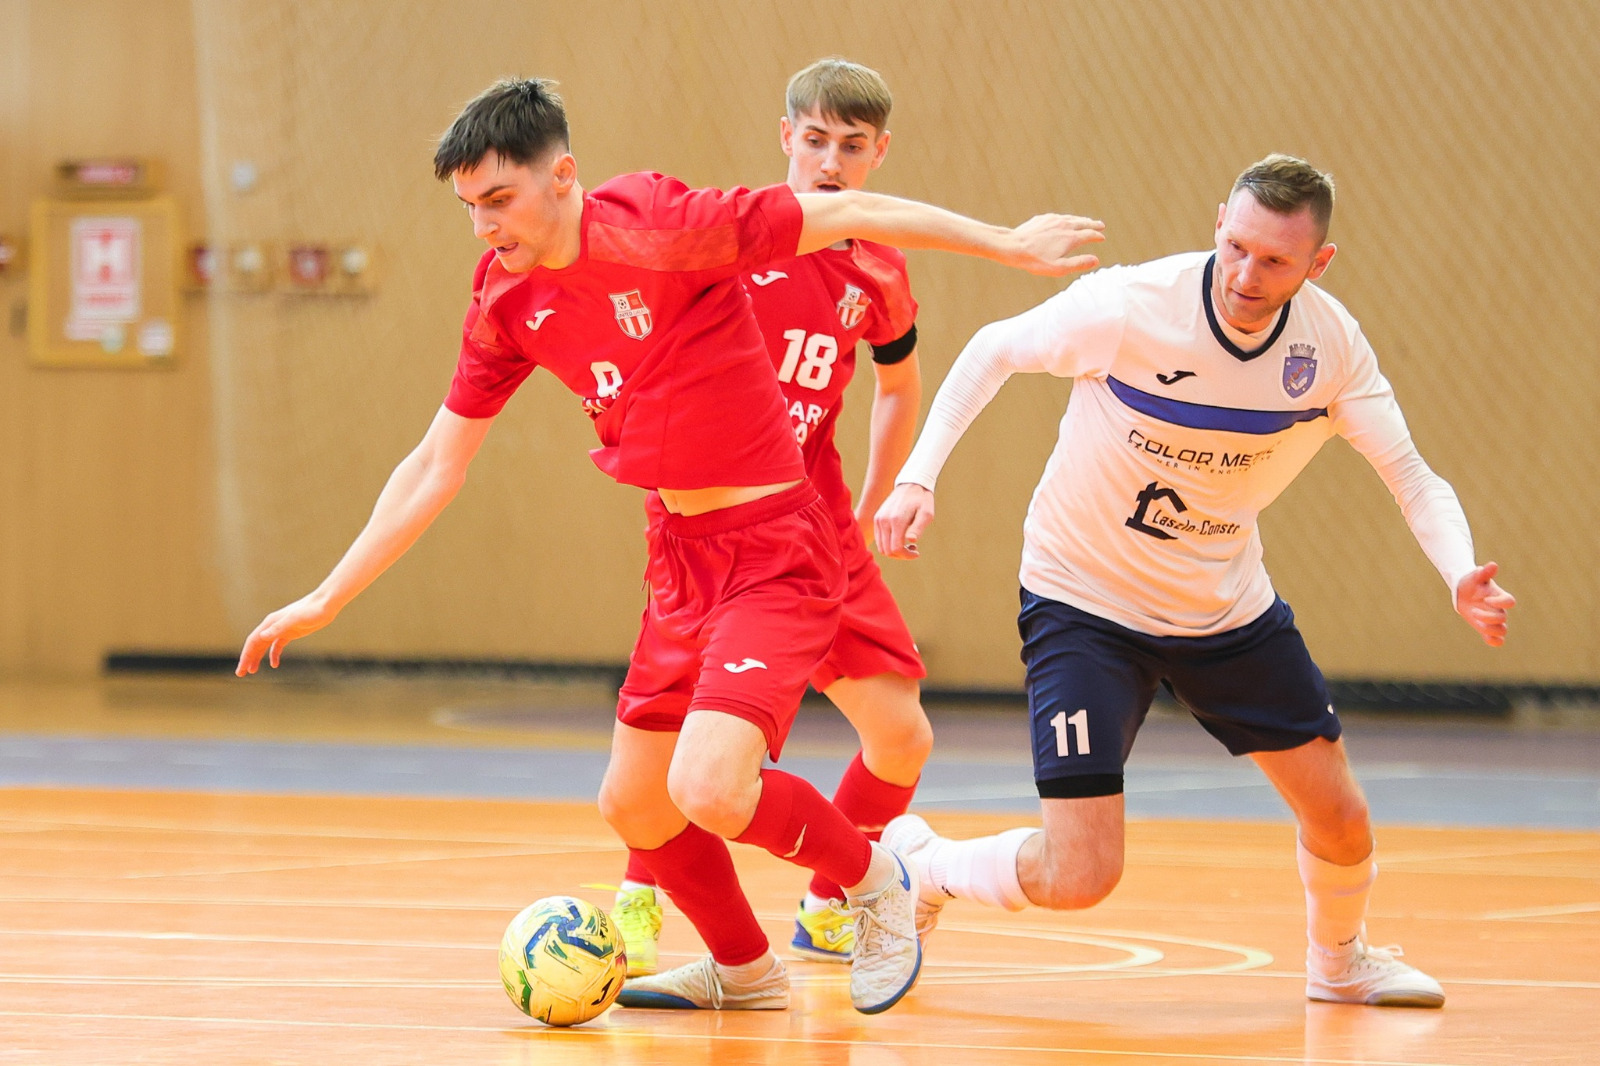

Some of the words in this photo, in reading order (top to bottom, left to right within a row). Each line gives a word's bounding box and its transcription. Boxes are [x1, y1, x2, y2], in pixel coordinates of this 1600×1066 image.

[778, 328, 839, 391] 18
[1128, 429, 1214, 466] COLOR
[1152, 509, 1241, 536] Laszlo-Constr
[1050, 709, 1091, 757] 11
